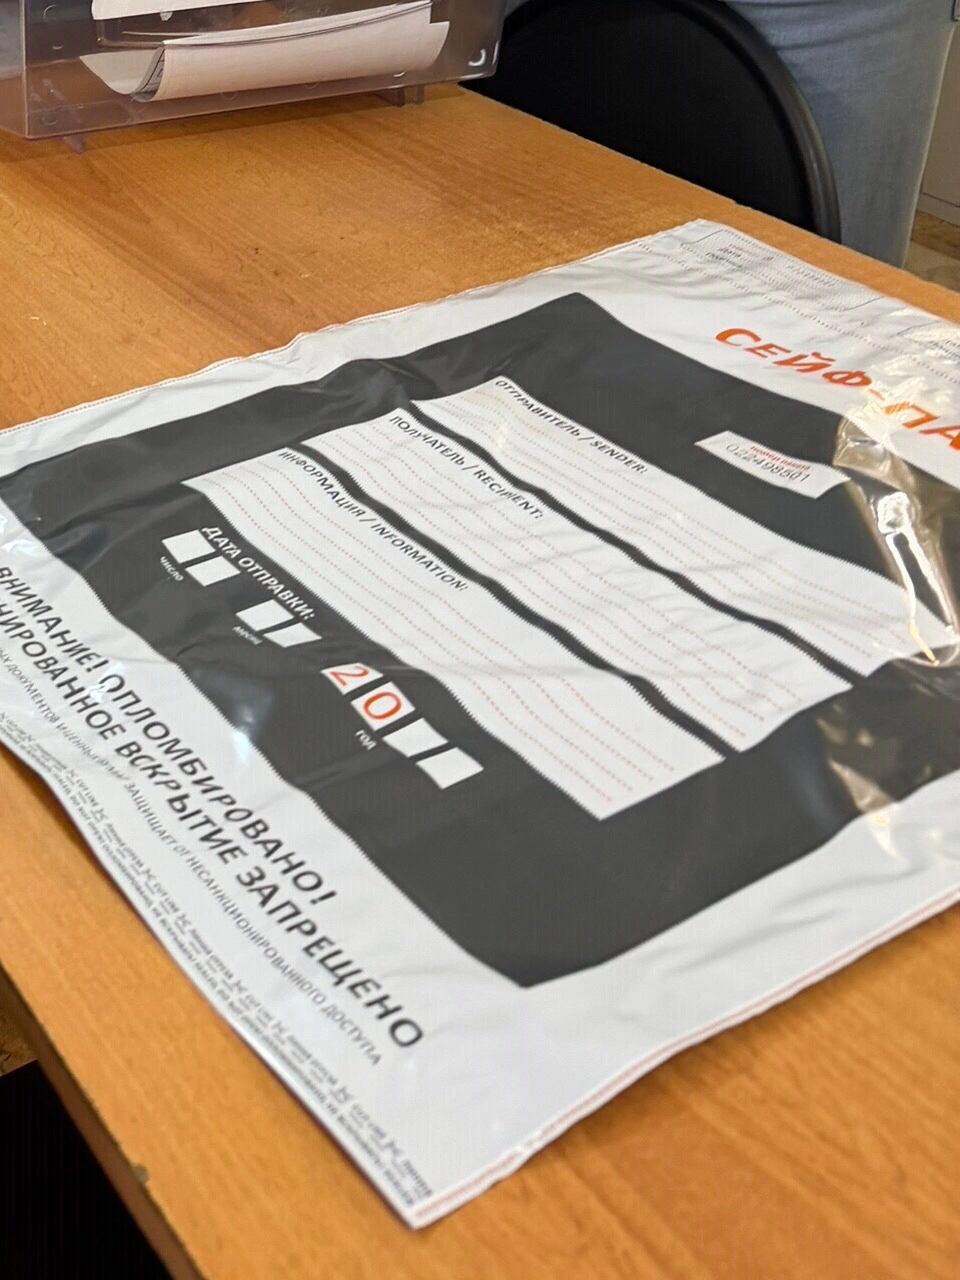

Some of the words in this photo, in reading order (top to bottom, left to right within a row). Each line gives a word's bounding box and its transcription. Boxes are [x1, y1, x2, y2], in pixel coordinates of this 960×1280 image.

[388, 414, 467, 473] ПОЛУЧАТЕЛЬ
[473, 468, 544, 522] RECIPIENT:
[494, 379, 583, 439] ОТПРАВИТЕЛЬ
[591, 439, 649, 475] SENDER:
[201, 526, 243, 566] ДАТА
[237, 552, 316, 622] ОТПРАВКИ:
[278, 451, 365, 518] ИНФОРМАЦИЯ
[370, 520, 469, 594] INFORMATION:
[99, 673, 337, 905] ОПЛОМБИРОВАНО!
[115, 741, 240, 865] ВСКРЫТИЕ
[236, 856, 424, 1049] ЗАПРЕЩЕНО
[321, 1004, 382, 1066] ДОСТУПА
